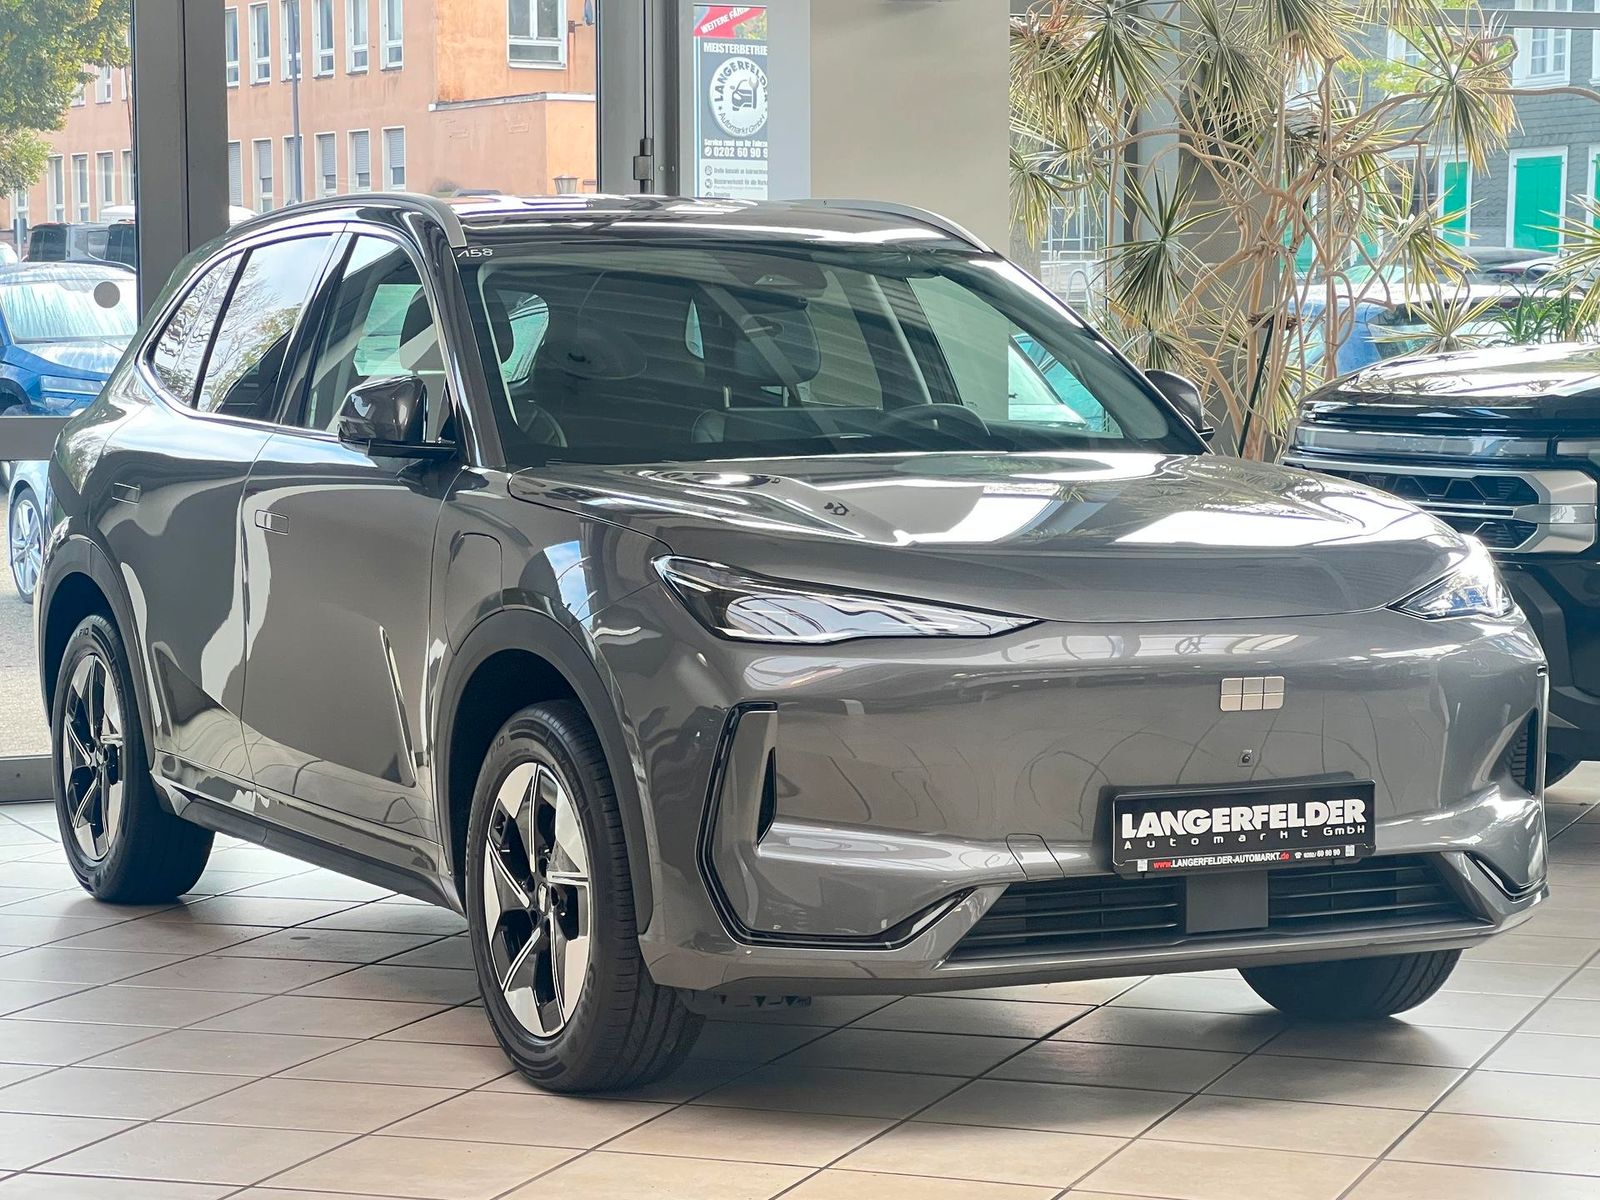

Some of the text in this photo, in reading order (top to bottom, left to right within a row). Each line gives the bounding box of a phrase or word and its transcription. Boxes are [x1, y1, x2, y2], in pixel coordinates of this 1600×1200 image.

[700, 14, 730, 33] WEITERE
[718, 112, 767, 135] Automarkt GmbH
[713, 147, 735, 157] 0202
[737, 147, 748, 158] 60
[750, 147, 761, 158] 90
[1121, 798, 1367, 839] LANGERFELDER
[1322, 825, 1366, 837] GmbH
[1153, 852, 1290, 869] www.LANGERFELDER-AUTOMARKT.de
